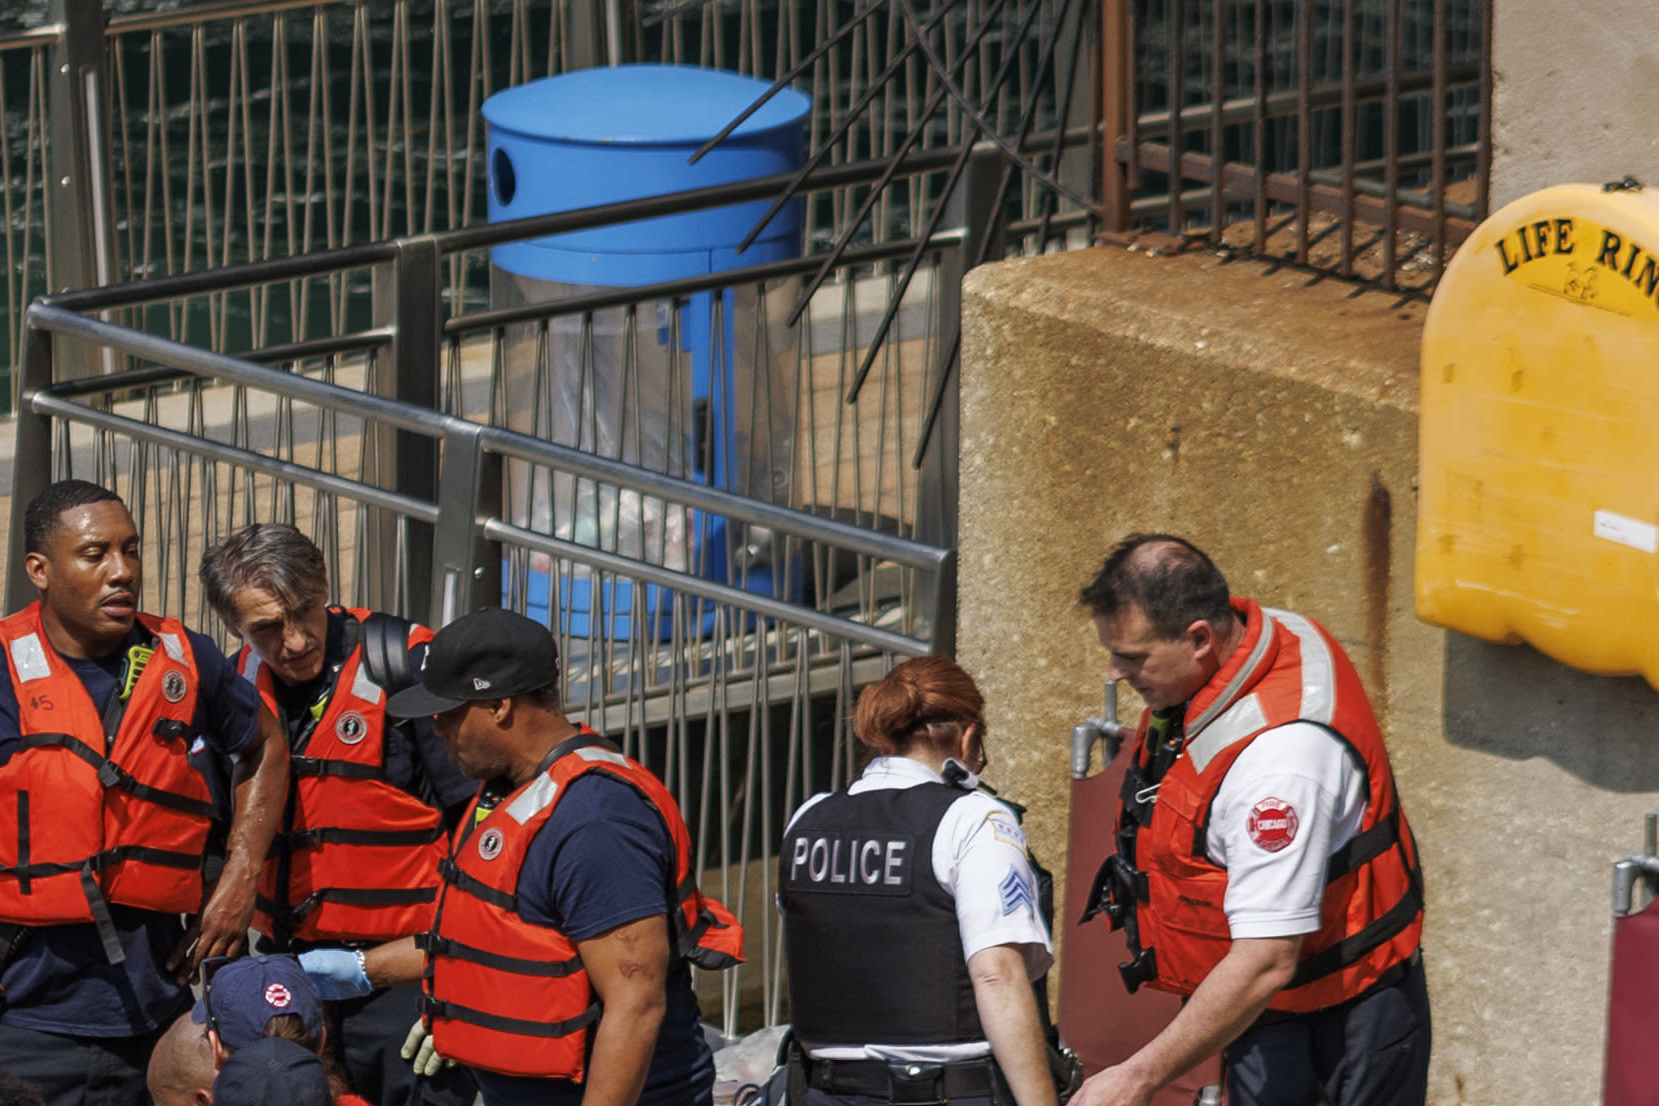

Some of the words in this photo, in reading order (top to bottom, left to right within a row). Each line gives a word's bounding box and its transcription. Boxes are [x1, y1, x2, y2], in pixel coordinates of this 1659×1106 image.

[1494, 218, 1576, 276] LIFE
[1595, 229, 1659, 312] RIN
[790, 837, 906, 885] POLICE
